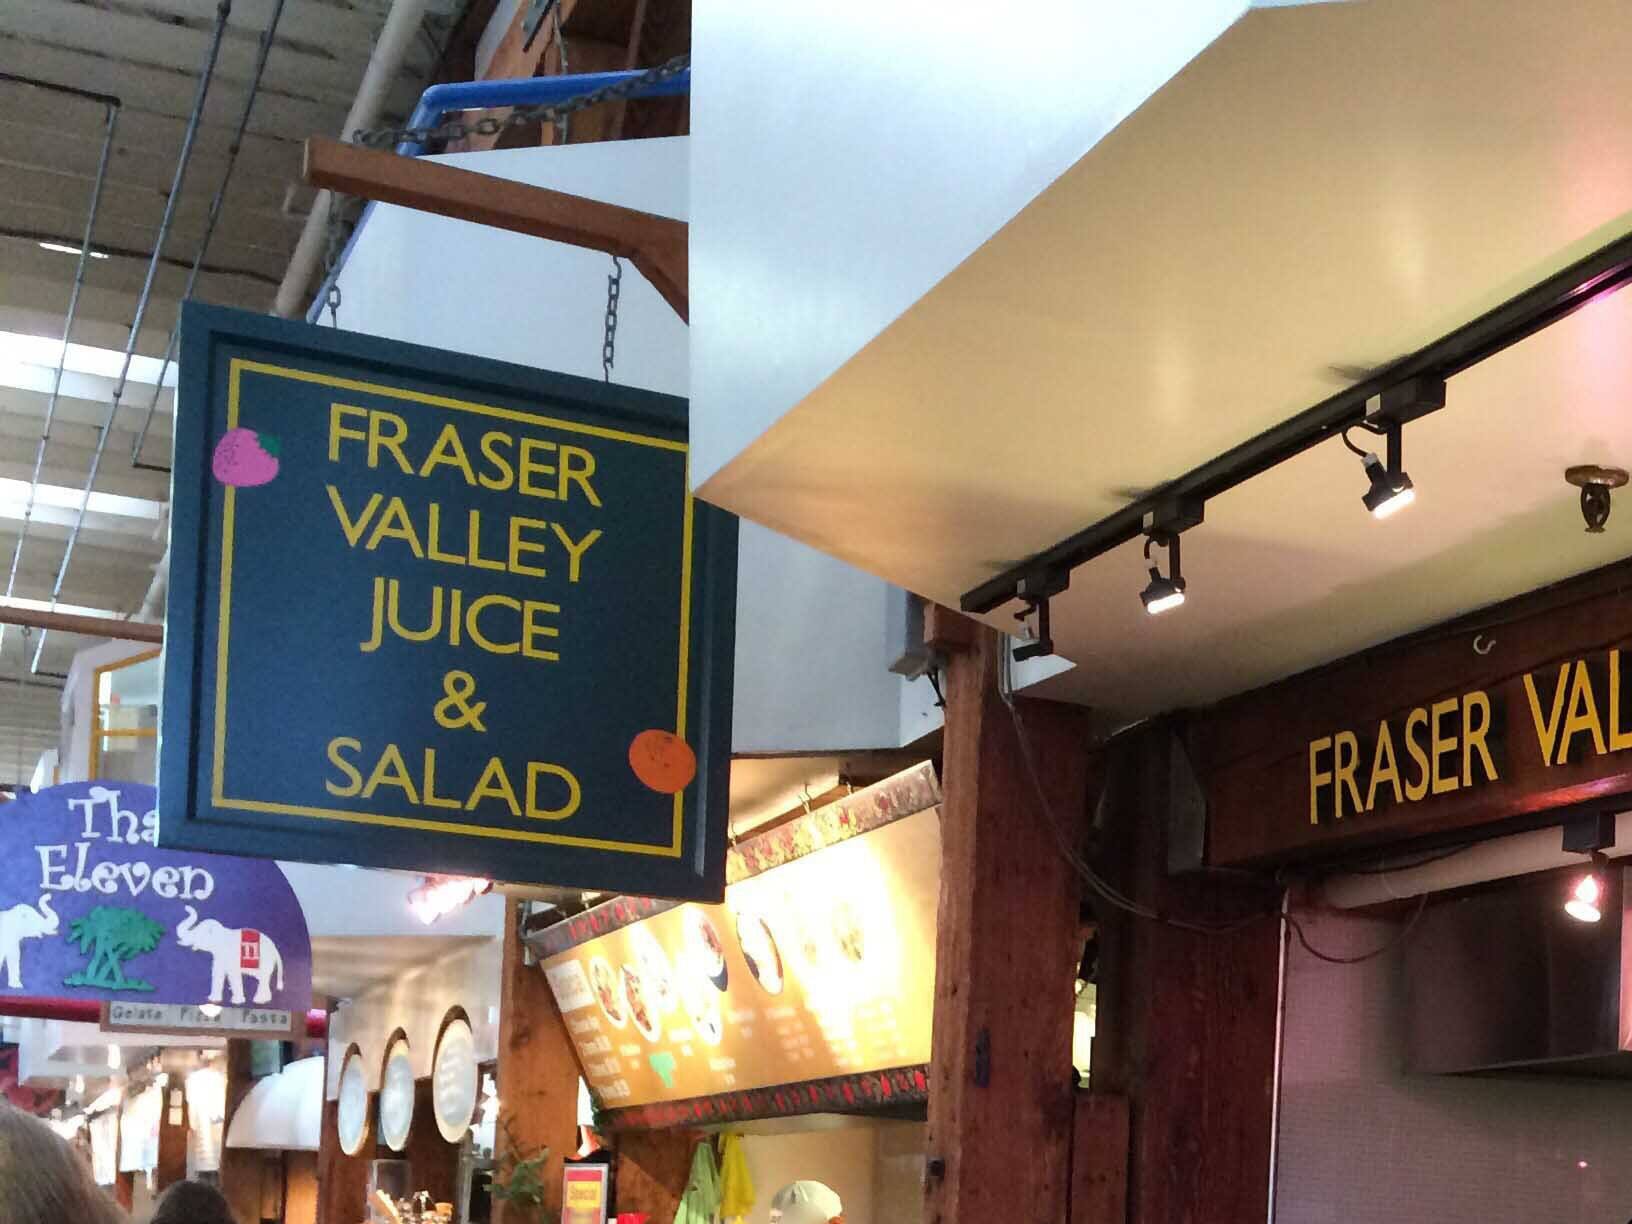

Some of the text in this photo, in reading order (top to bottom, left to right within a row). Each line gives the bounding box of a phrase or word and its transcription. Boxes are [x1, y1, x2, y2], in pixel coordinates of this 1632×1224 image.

[329, 402, 603, 508] FRASER
[326, 485, 605, 583] VALLEY
[360, 576, 561, 662] JUICE
[434, 670, 487, 732] &
[325, 736, 582, 822] SALAD
[1307, 690, 1496, 826] FRASER
[68, 786, 159, 844] Tha
[35, 841, 214, 900] Eleven
[242, 1009, 287, 1025] Pasta
